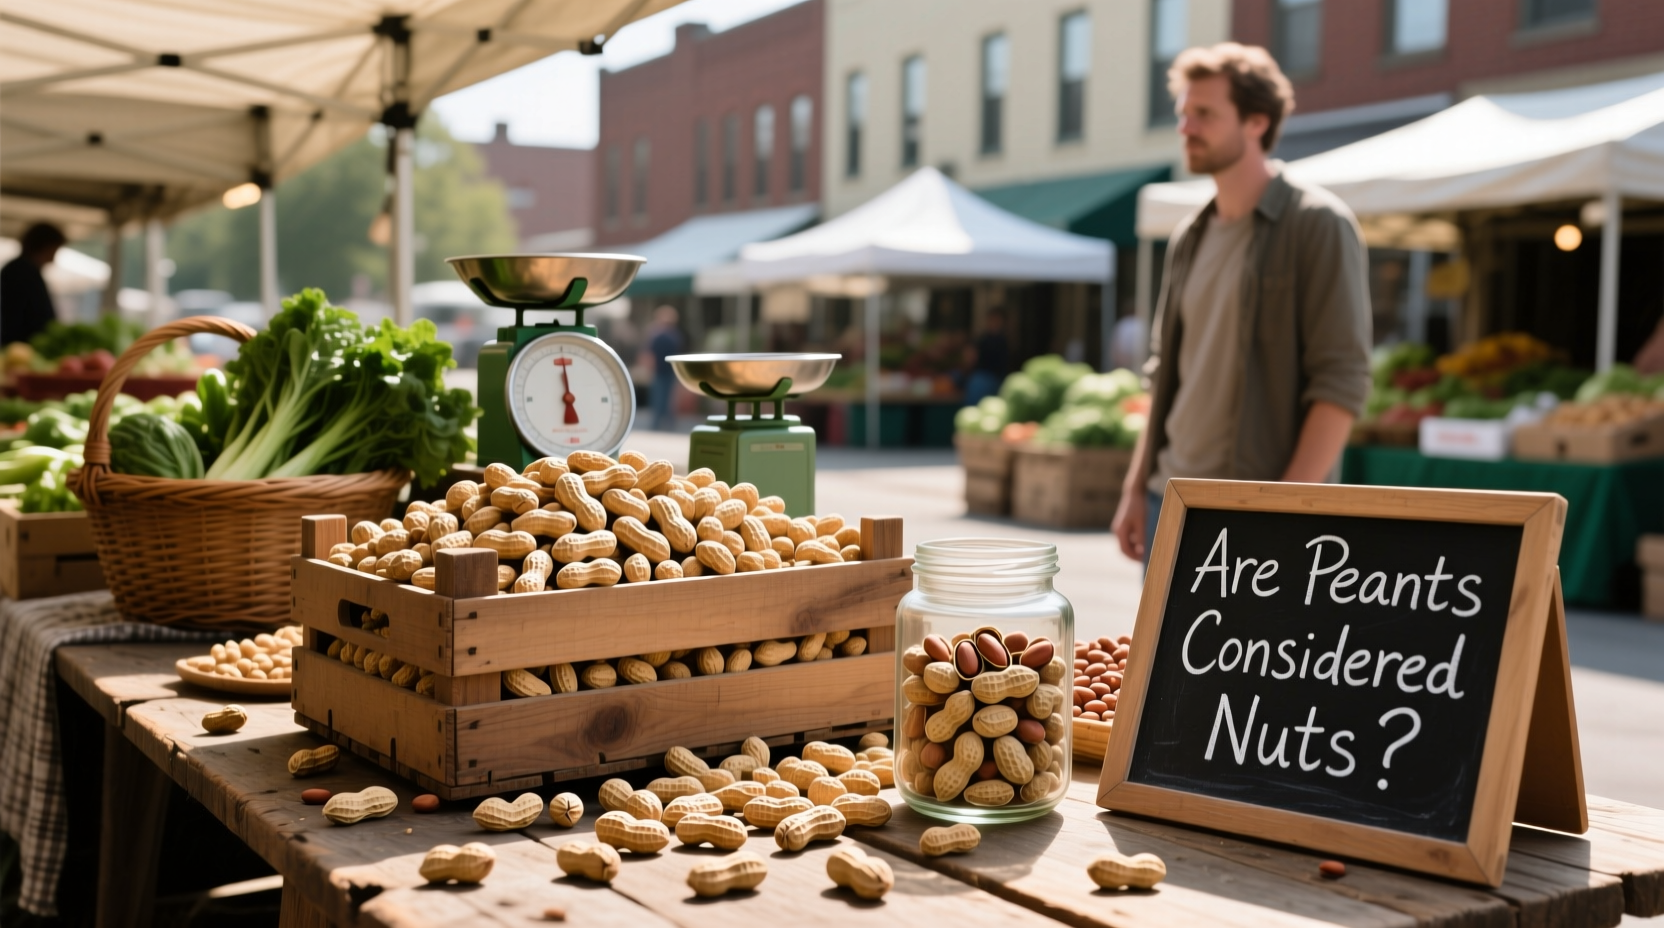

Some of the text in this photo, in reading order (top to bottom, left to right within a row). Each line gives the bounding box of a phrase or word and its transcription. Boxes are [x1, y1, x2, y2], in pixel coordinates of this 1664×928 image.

[1190, 527, 1482, 617] Are Peants
[1181, 609, 1466, 699] Considered
[1204, 693, 1356, 777] Nuts
